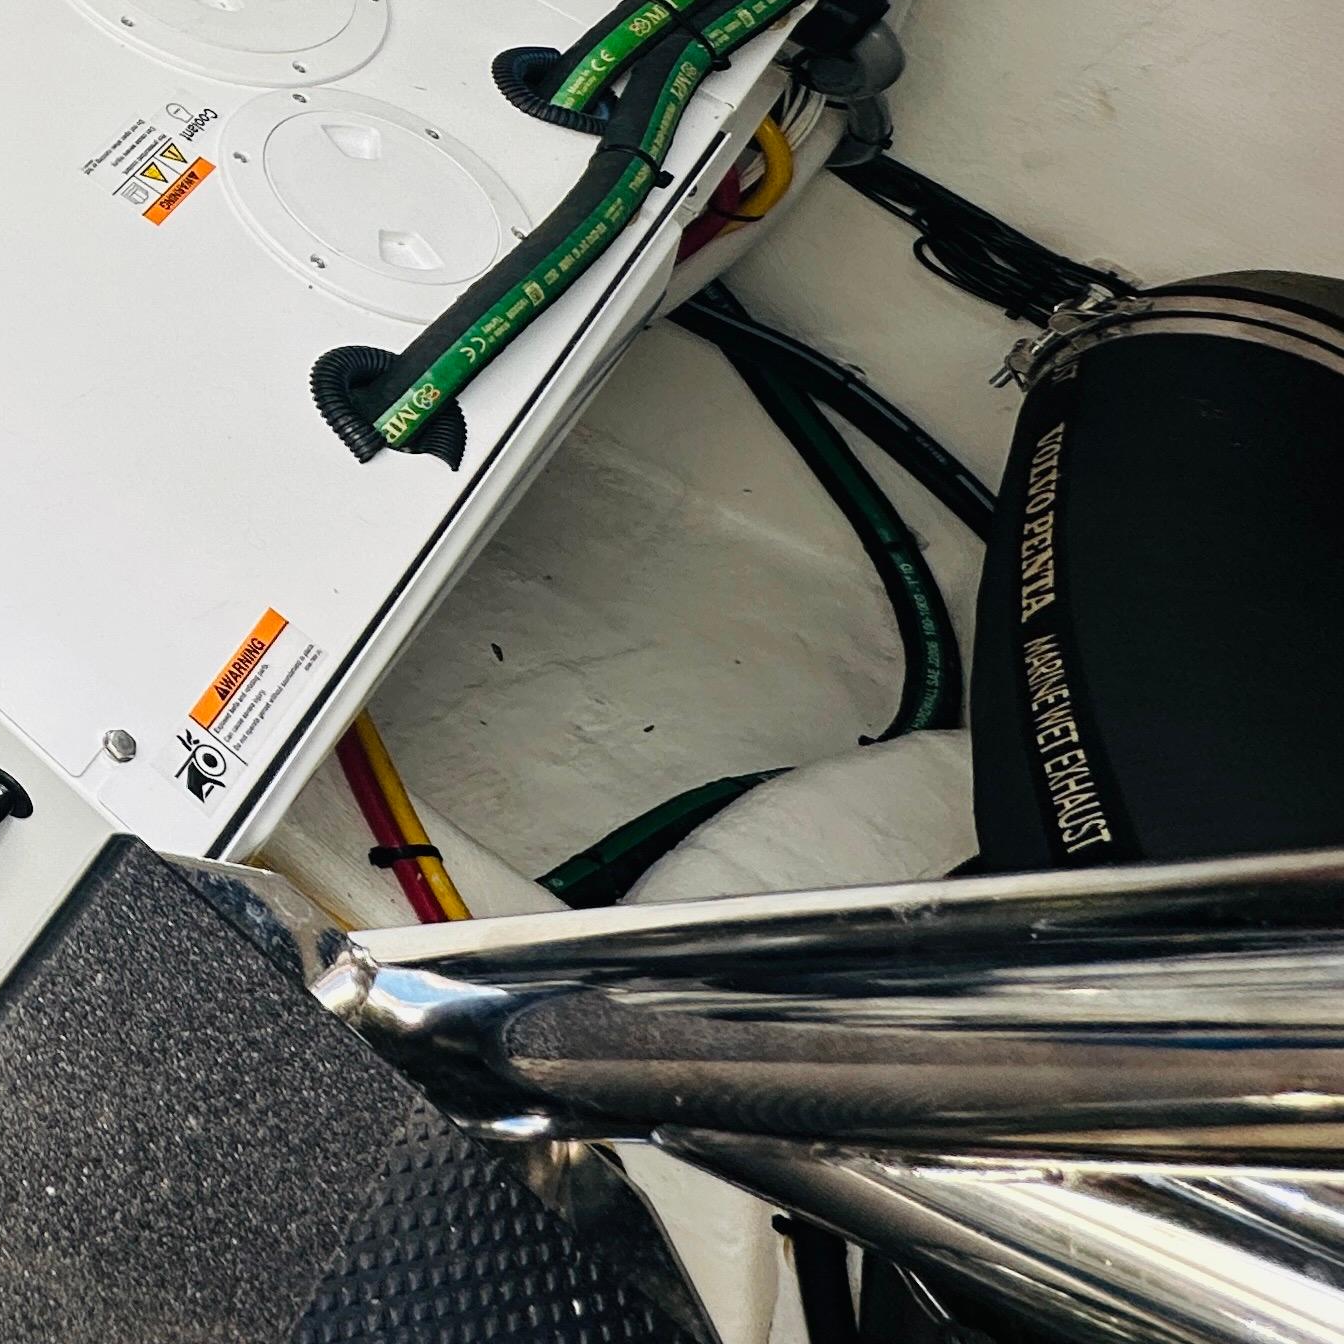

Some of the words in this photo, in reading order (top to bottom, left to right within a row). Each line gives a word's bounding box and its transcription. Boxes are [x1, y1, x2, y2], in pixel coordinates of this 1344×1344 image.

[179, 106, 220, 143] Coolant
[159, 174, 194, 210] WARNING
[377, 401, 420, 445] MP
[1024, 421, 1067, 517] VOLVO
[1021, 509, 1057, 624] PENTA
[218, 637, 266, 693] WARNING
[925, 667, 940, 686] SAE
[1025, 632, 1066, 710] MARINE
[1037, 701, 1080, 759] WET
[1044, 750, 1113, 854] EXHAUST
